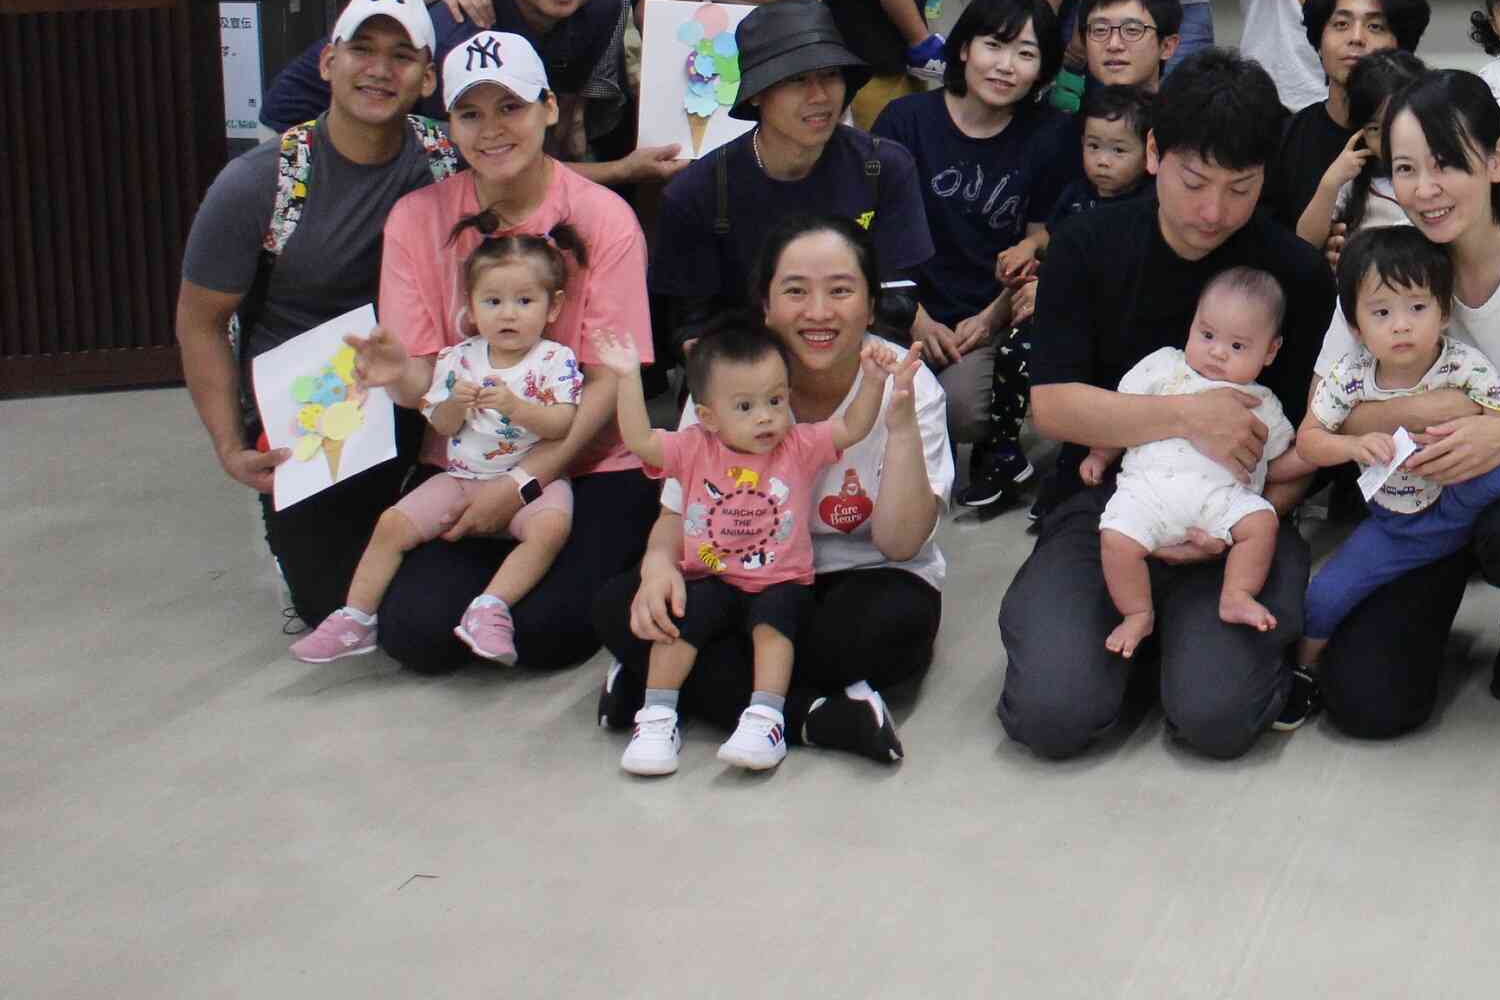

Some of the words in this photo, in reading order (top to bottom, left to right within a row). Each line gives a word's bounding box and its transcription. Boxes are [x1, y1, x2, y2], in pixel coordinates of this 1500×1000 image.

[466, 36, 503, 71] NY
[833, 503, 858, 514] Care
[735, 519, 752, 527] THE
